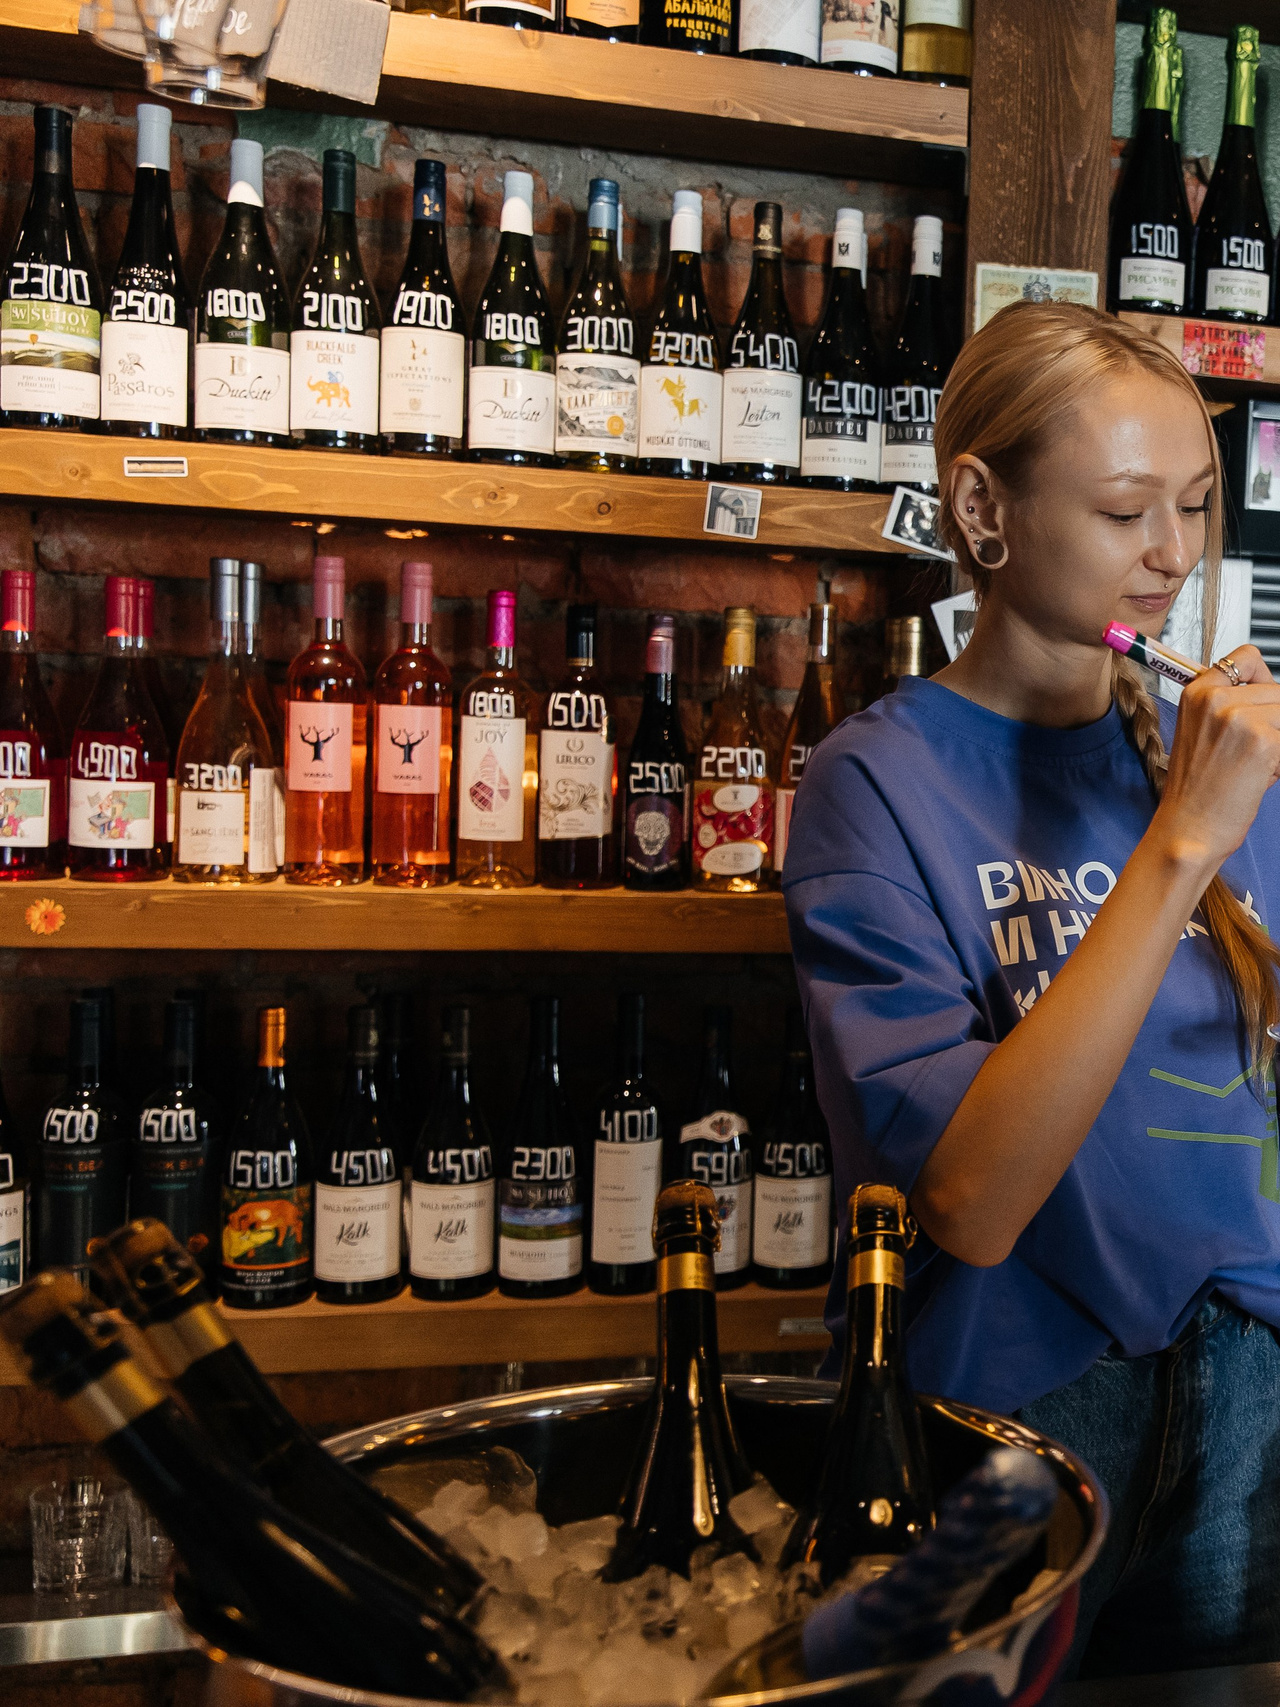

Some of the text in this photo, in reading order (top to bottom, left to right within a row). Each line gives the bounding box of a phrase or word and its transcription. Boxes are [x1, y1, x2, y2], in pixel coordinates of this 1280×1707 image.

[1131, 223, 1179, 259] 1500
[1222, 236, 1265, 271] 1500
[9, 262, 91, 306] 2300
[111, 290, 176, 325] 2500
[207, 288, 266, 322] 1800
[302, 291, 363, 331] 2100
[393, 290, 453, 330] 1900
[484, 313, 541, 346] 1800
[566, 316, 634, 354] 3000
[650, 331, 714, 369] 3200
[731, 333, 800, 372] 5400
[809, 380, 877, 416] 4200
[808, 419, 864, 437] DAUTEL
[888, 427, 935, 443] DAUTE
[469, 691, 515, 718] 1800
[547, 691, 606, 728] 1500
[475, 730, 508, 745] JOY
[78, 741, 137, 780] 4900
[184, 762, 243, 792] 3200
[555, 754, 596, 767] LIRICO
[629, 761, 685, 794] 2500
[701, 745, 766, 779] 2200
[976, 859, 1118, 911] ВИНО
[990, 915, 1038, 967] И
[44, 1108, 99, 1143] 1500
[140, 1108, 197, 1142] 1500
[600, 1109, 658, 1141] 4100
[229, 1150, 294, 1188] 1500
[331, 1148, 396, 1186] 4500
[428, 1145, 492, 1184] 4500
[511, 1146, 576, 1180] 2300
[763, 1142, 826, 1177] 4500
